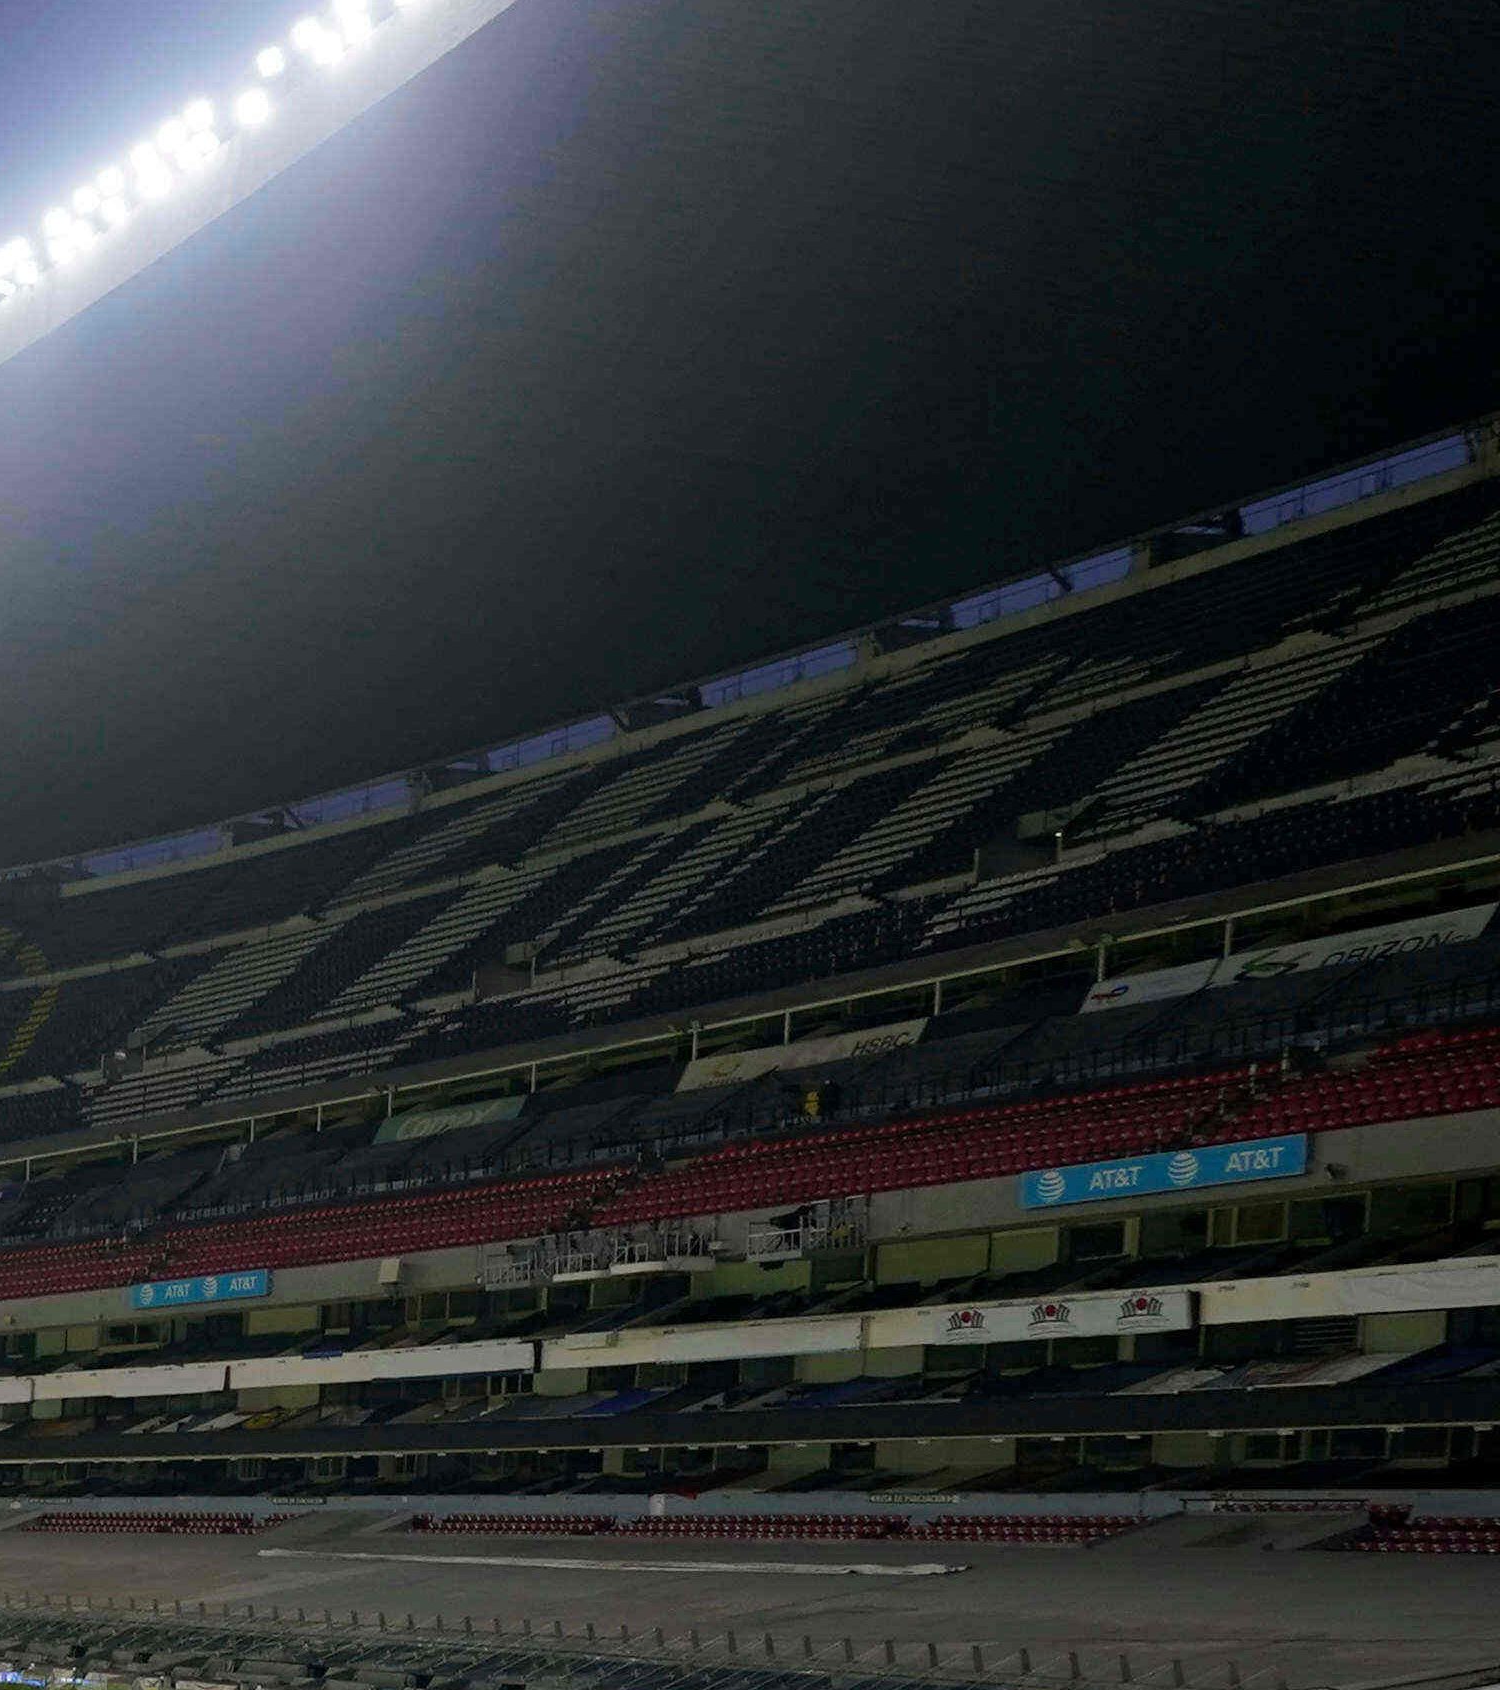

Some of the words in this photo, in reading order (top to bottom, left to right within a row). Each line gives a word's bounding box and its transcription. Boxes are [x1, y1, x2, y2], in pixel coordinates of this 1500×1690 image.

[1225, 1146, 1285, 1173] AT&T
[1088, 1166, 1145, 1191] AT&T
[165, 1283, 191, 1299] AT&T
[229, 1276, 258, 1292] AT&T
